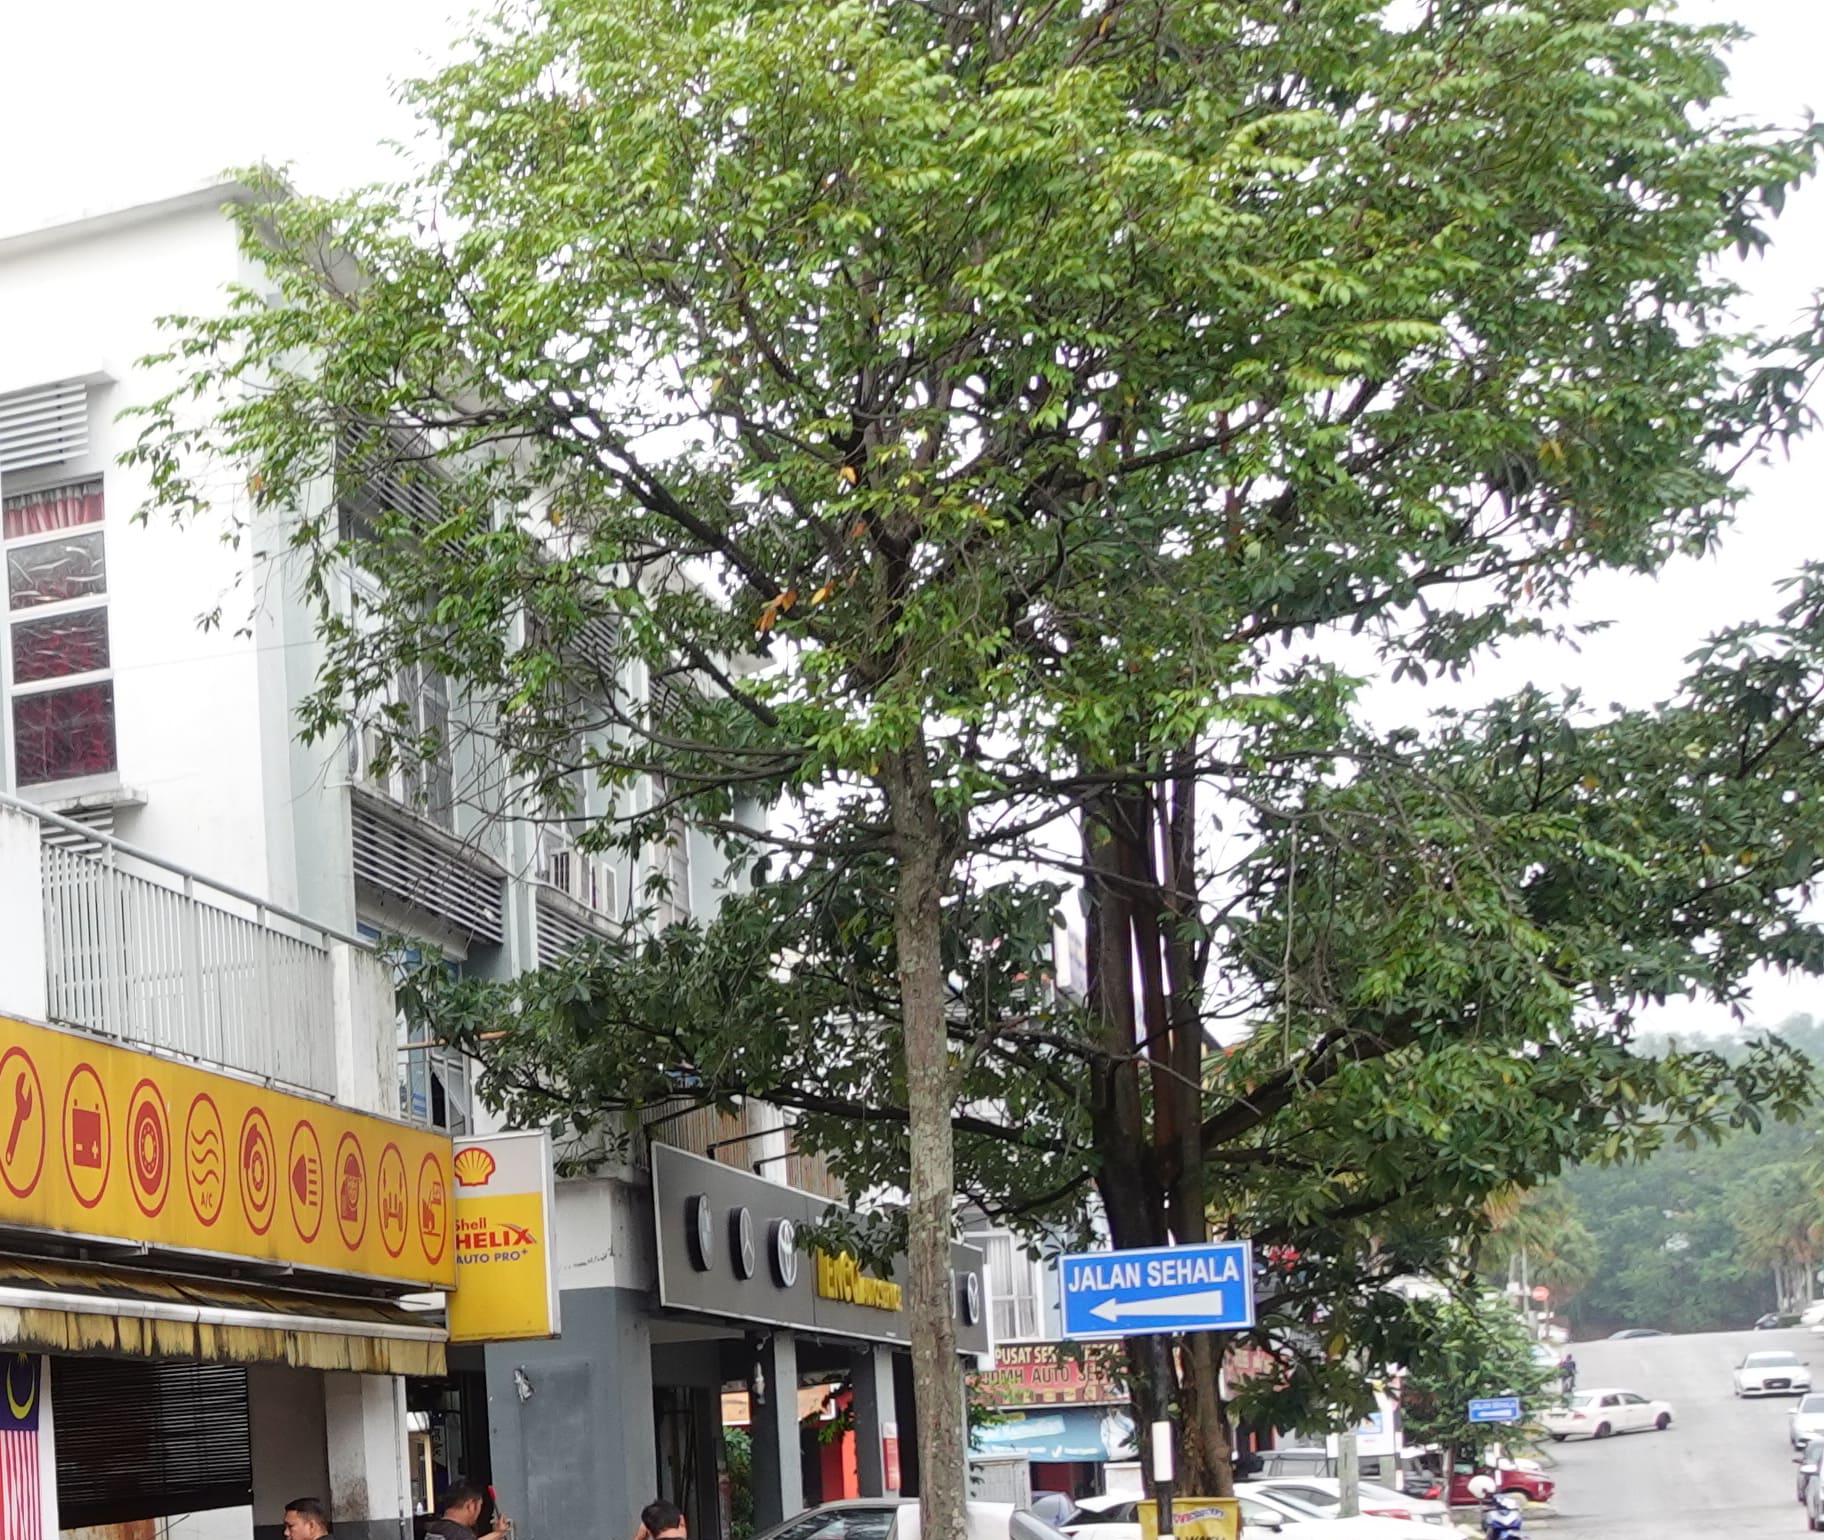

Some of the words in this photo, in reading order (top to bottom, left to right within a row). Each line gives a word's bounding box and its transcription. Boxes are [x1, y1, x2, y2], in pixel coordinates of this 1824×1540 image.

[200, 1192, 213, 1209] A/C
[456, 1224, 537, 1250] HELIX
[457, 1254, 490, 1264] AUTO
[1068, 1262, 1141, 1292] JALAN
[1147, 1255, 1240, 1288] SEHALA
[995, 1346, 1032, 1365] PUSAT
[1032, 1366, 1070, 1383] AUTO
